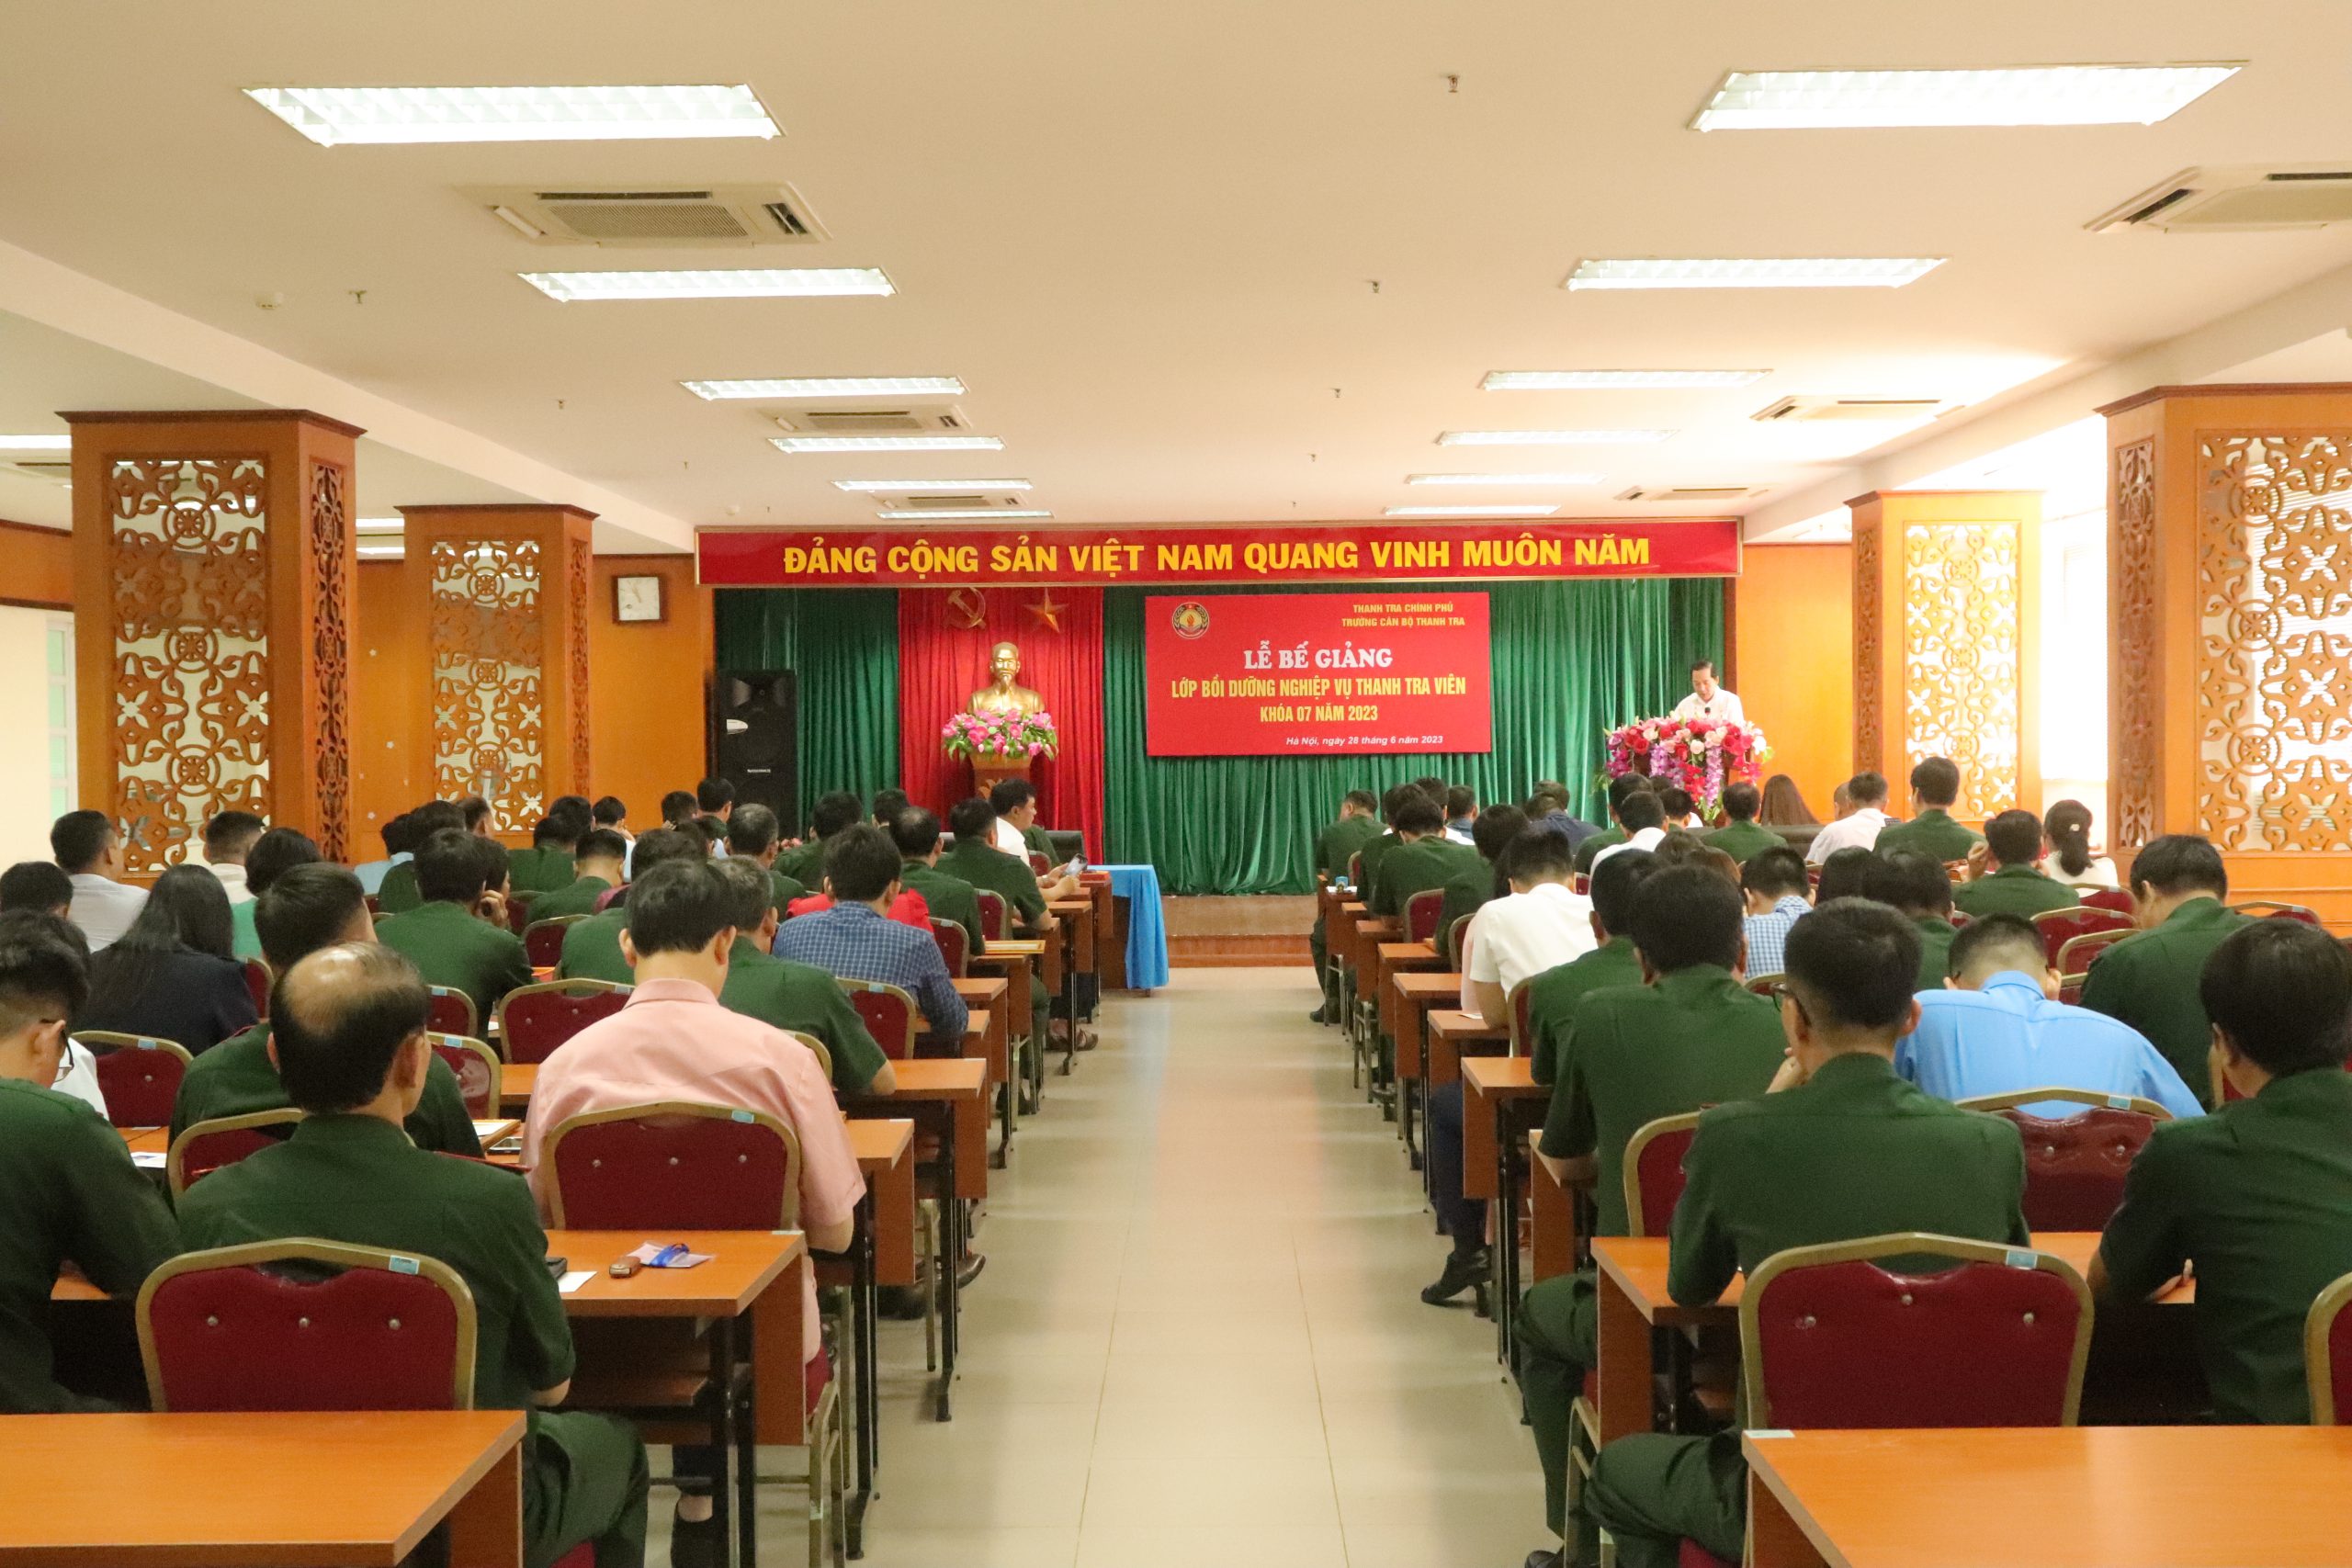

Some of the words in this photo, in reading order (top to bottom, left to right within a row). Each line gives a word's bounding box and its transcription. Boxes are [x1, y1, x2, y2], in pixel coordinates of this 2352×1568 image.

[784, 536, 876, 573] ĐẢNG
[888, 539, 978, 579] CỘNG
[990, 536, 1057, 571] SẢN
[1069, 538, 1144, 577] VIỆT
[1158, 544, 1232, 570] NAM
[1244, 541, 1358, 573] QUANG
[1370, 541, 1449, 568] VINH
[1464, 533, 1562, 567] MUÔN
[1575, 532, 1650, 566] NĂM
[1353, 604, 1383, 613] THANH
[1385, 604, 1402, 613] TRA
[1405, 603, 1432, 612] CHÍNH
[1380, 616, 1399, 626] CÁN
[1401, 616, 1413, 627] BỘ
[1416, 617, 1445, 626] THANH
[1448, 617, 1465, 626] TRA
[1244, 640, 1272, 669] LỄ
[1279, 641, 1308, 669] BẾ
[1316, 641, 1393, 668] GIẢNG
[1172, 677, 1197, 698] LỚP
[1228, 676, 1275, 697] DƯỠNG
[1280, 675, 1330, 700] NGHIỆP
[1334, 679, 1351, 699] VỤ
[1356, 678, 1401, 695] THANH
[1405, 678, 1430, 694] TRA
[1434, 673, 1465, 694] VIÊN
[1261, 705, 1294, 722] KHÓA
[1297, 706, 1312, 722] 07
[1316, 704, 1345, 722] NĂM
[1348, 705, 1378, 721] 2023
[1286, 737, 1299, 745] Hà
[1302, 737, 1319, 747] Nội,
[1322, 737, 1345, 747] ngày
[1362, 736, 1387, 747] tháng
[1390, 736, 1396, 744] 6
[1398, 736, 1419, 744] năm
